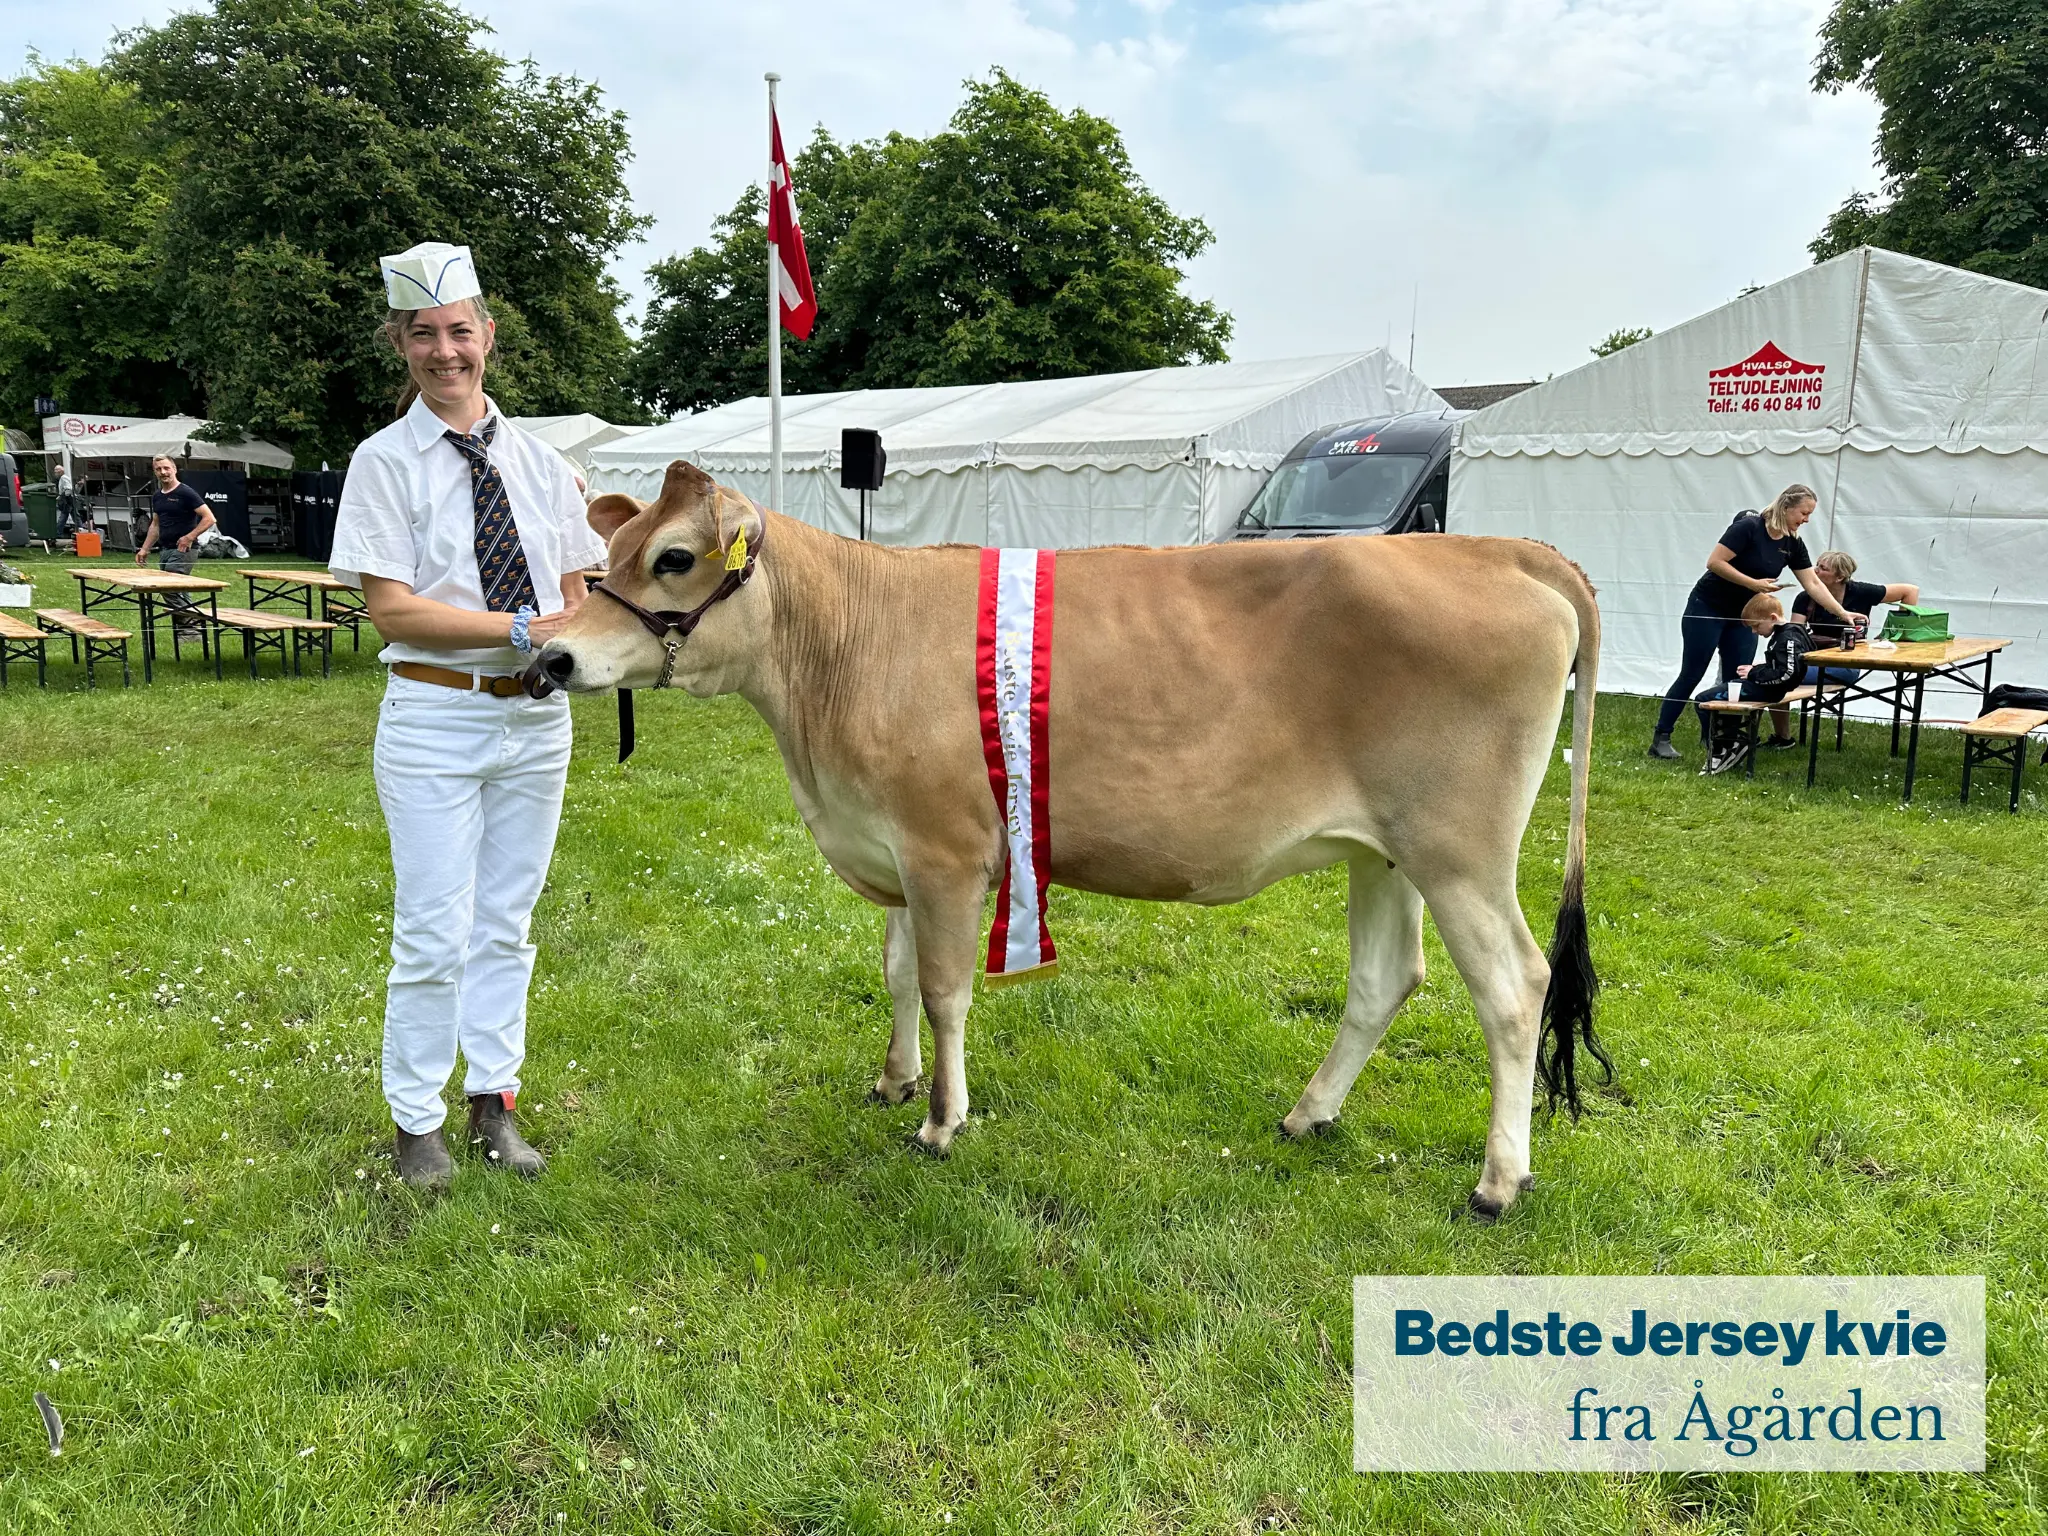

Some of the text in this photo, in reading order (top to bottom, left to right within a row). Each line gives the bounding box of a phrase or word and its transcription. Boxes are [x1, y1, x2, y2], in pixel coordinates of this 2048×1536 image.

[1741, 360, 1793, 371] HVALSØ
[1708, 377, 1822, 396] TELTUDLEJNING
[1707, 395, 1821, 413] Telf.: 46 40 84 10
[87, 424, 129, 434] KÆM
[1328, 444, 1359, 456] CARE
[1007, 768, 1023, 838] Jersey
